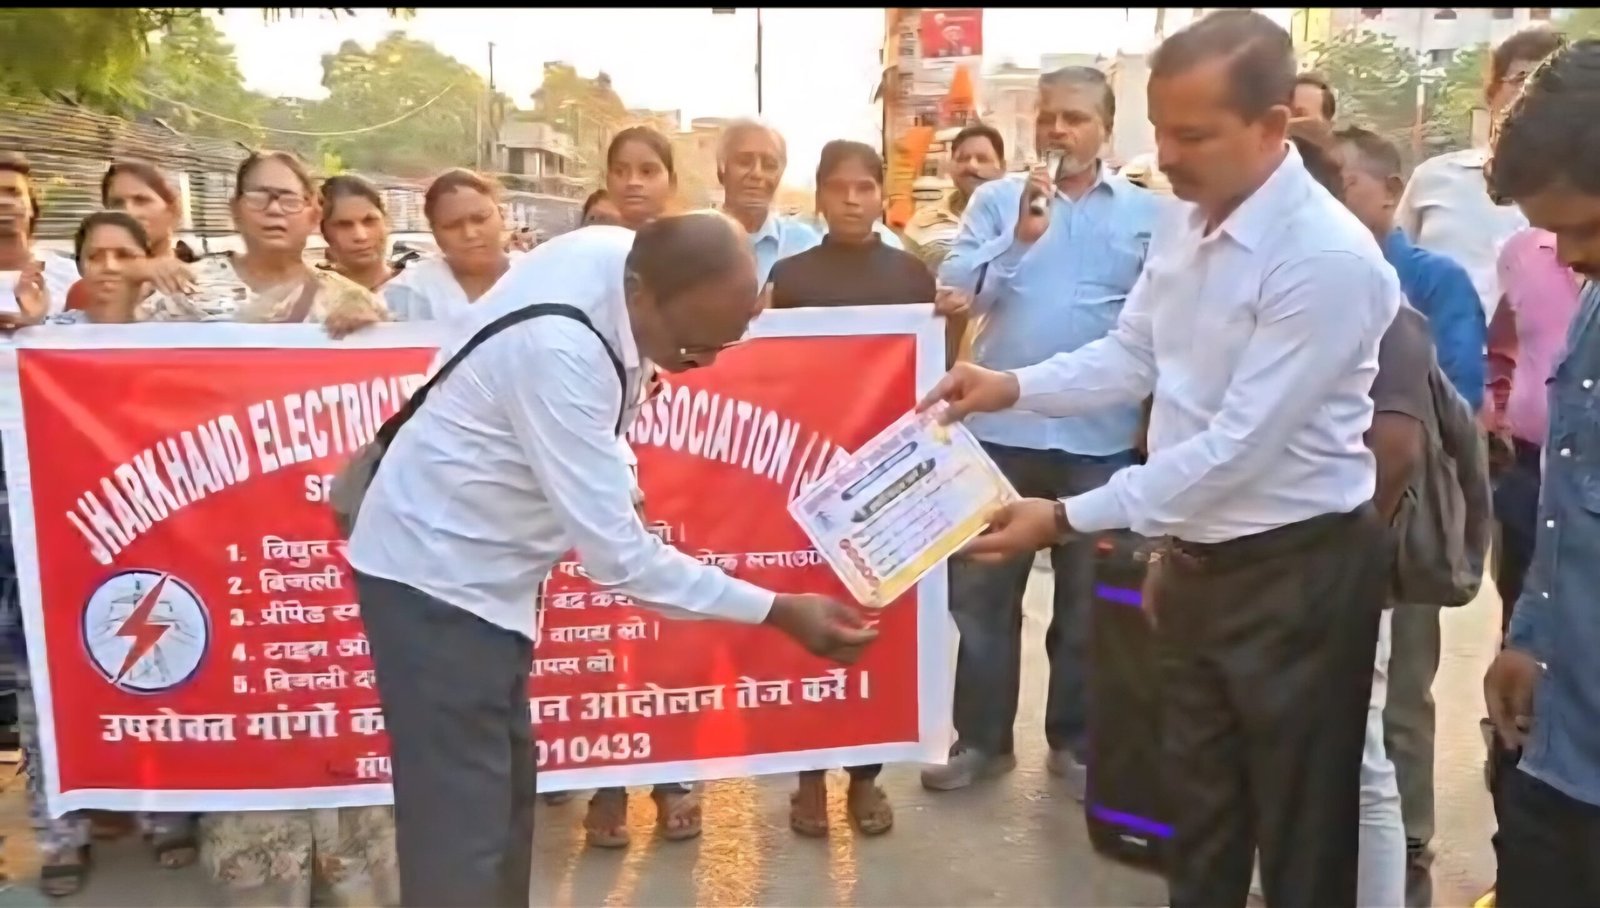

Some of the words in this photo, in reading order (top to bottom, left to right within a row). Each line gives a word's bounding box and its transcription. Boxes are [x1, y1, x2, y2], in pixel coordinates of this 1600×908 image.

[65, 414, 250, 566] JHARKHAND
[247, 372, 427, 474] ELECTRICIT
[225, 543, 248, 562] 1.
[227, 576, 253, 595] 2.
[580, 679, 726, 721] आंदोलन
[735, 675, 793, 709] तेज
[98, 706, 237, 742] उपरोक्त
